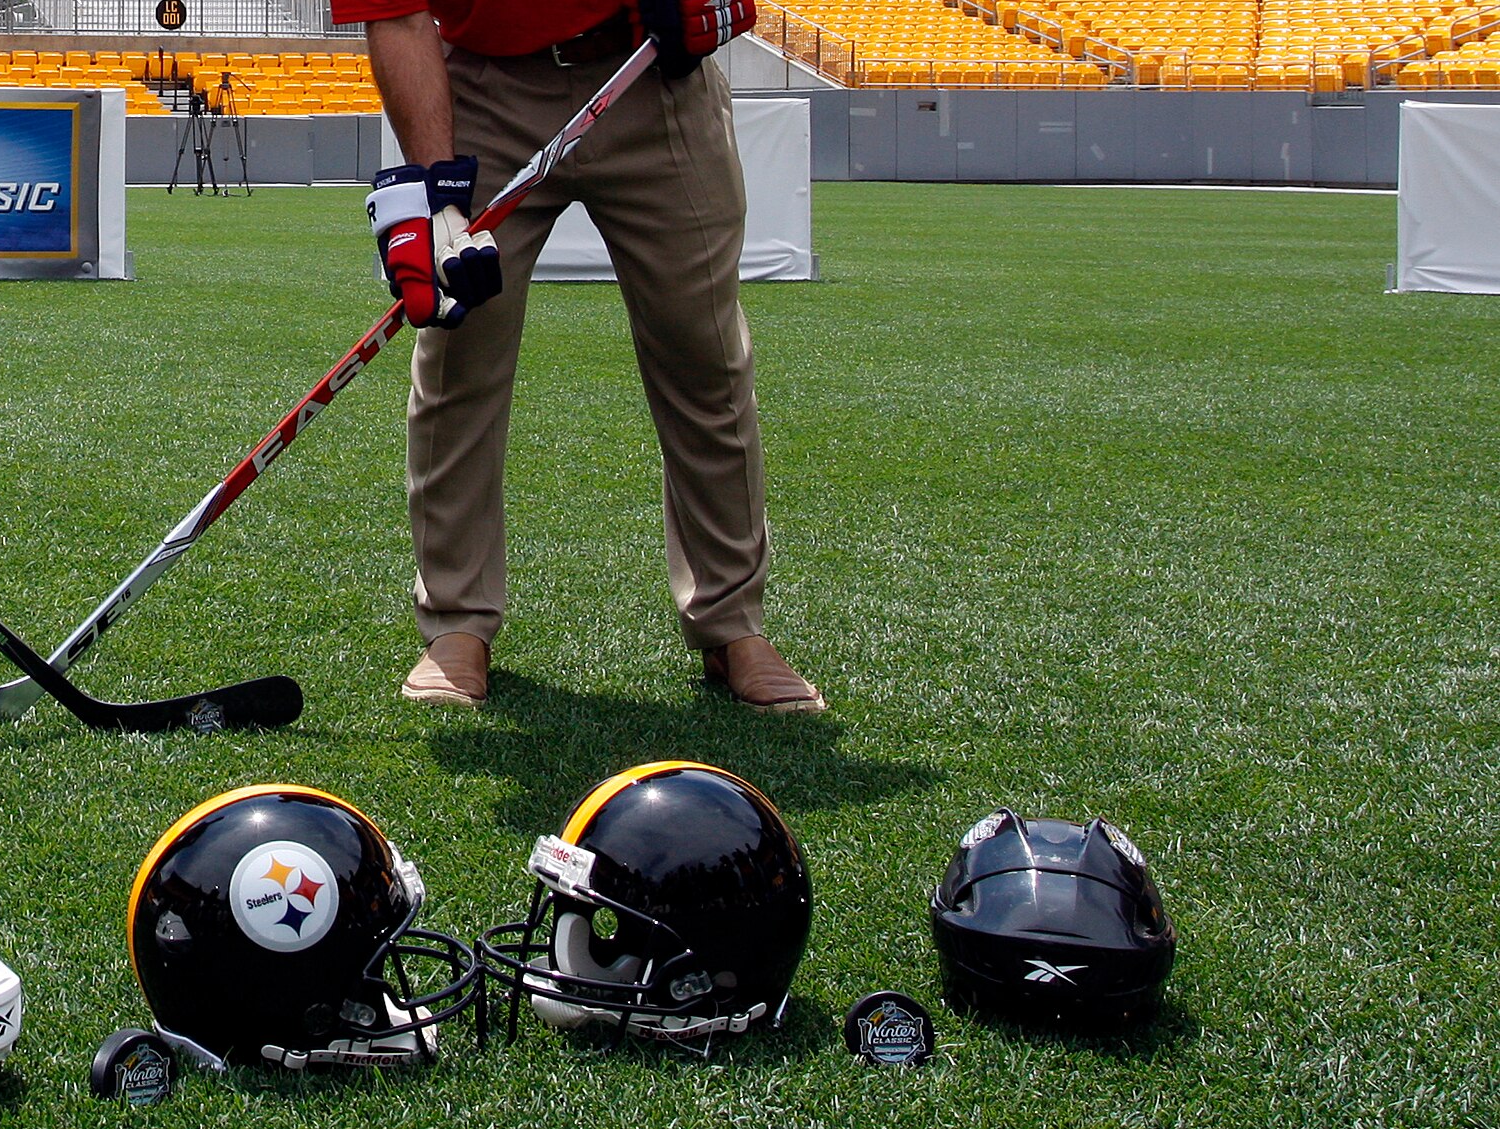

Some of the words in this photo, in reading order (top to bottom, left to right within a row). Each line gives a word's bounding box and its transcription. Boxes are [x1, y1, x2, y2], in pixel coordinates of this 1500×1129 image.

[165, 0, 178, 13] LC
[163, 13, 180, 25] 001
[437, 179, 471, 188] BAUER
[251, 313, 408, 474] EAST
[246, 892, 283, 910] Steelers
[863, 1016, 917, 1045] Winter
[121, 1058, 164, 1091] Winter
